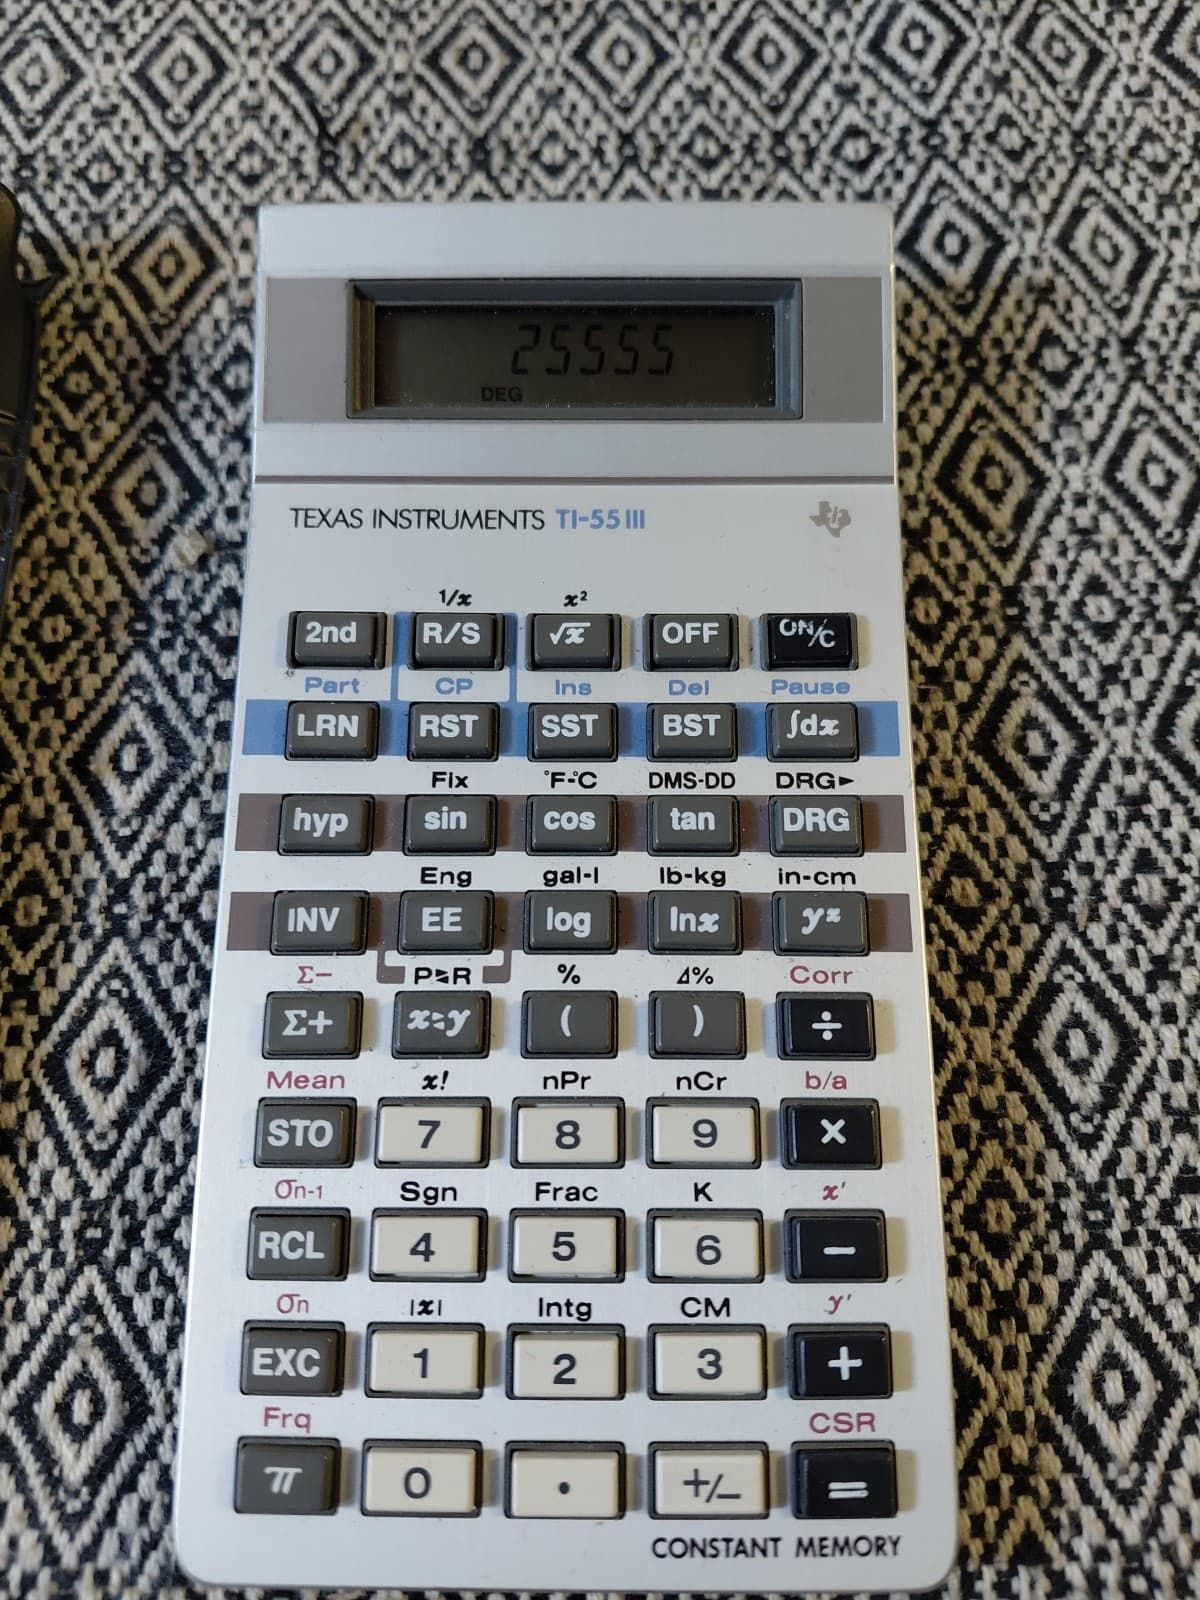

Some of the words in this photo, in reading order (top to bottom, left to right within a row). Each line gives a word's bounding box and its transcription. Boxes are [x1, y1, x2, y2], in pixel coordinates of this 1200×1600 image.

[481, 385, 523, 401] DEG
[290, 508, 364, 529] TEXAS
[372, 509, 546, 530] INSTRUMENTS
[556, 509, 621, 529] TI-55
[626, 510, 645, 529] III
[305, 621, 357, 643] 2nd
[423, 622, 480, 645] R/S
[662, 622, 719, 644] OFF
[305, 676, 360, 694] Part
[435, 677, 473, 695] CP
[555, 679, 592, 696] Ins
[668, 679, 709, 696] Del
[771, 678, 850, 695] Pause
[297, 714, 359, 737] LRN
[419, 714, 479, 737] RST
[541, 714, 598, 738] SST
[662, 714, 721, 737] BST
[432, 772, 469, 788] Fix
[649, 772, 736, 789] DMS-DD
[293, 807, 349, 837] hyp
[424, 807, 467, 830] sin
[544, 809, 596, 830] cos
[670, 808, 715, 831] tan
[783, 808, 850, 832] DRG
[420, 867, 472, 887] Eng
[660, 867, 727, 887] lb-kg
[778, 868, 856, 885] in-cm
[288, 907, 340, 932] INV
[422, 907, 463, 932] EE
[546, 907, 592, 937] log
[557, 964, 581, 984] %
[789, 966, 853, 984] Corr
[267, 1071, 345, 1089] Mean
[422, 1070, 449, 1090] x!
[543, 1072, 591, 1089] nPr
[676, 1072, 727, 1091] nCr
[805, 1071, 848, 1090] b/a
[267, 1119, 333, 1147] STO
[418, 1120, 441, 1149] 7
[555, 1120, 581, 1150] 8
[692, 1119, 718, 1148] 9
[400, 1182, 457, 1205] Sgn
[535, 1182, 598, 1202] Frac
[694, 1183, 713, 1202] K
[258, 1231, 325, 1260] RCL
[410, 1233, 435, 1262] 4
[552, 1232, 576, 1261] 5
[696, 1235, 721, 1265] 6
[539, 1298, 592, 1321] Intg
[680, 1297, 730, 1318] CM
[252, 1348, 320, 1378] EXC
[413, 1348, 429, 1378] 1
[553, 1353, 577, 1385] 2
[697, 1348, 722, 1380] 3
[263, 1407, 311, 1433] Frq
[809, 1412, 876, 1433] CSR
[403, 1467, 431, 1499] 0
[652, 1537, 782, 1559] CONSTANT
[795, 1536, 901, 1558] MEMORY
